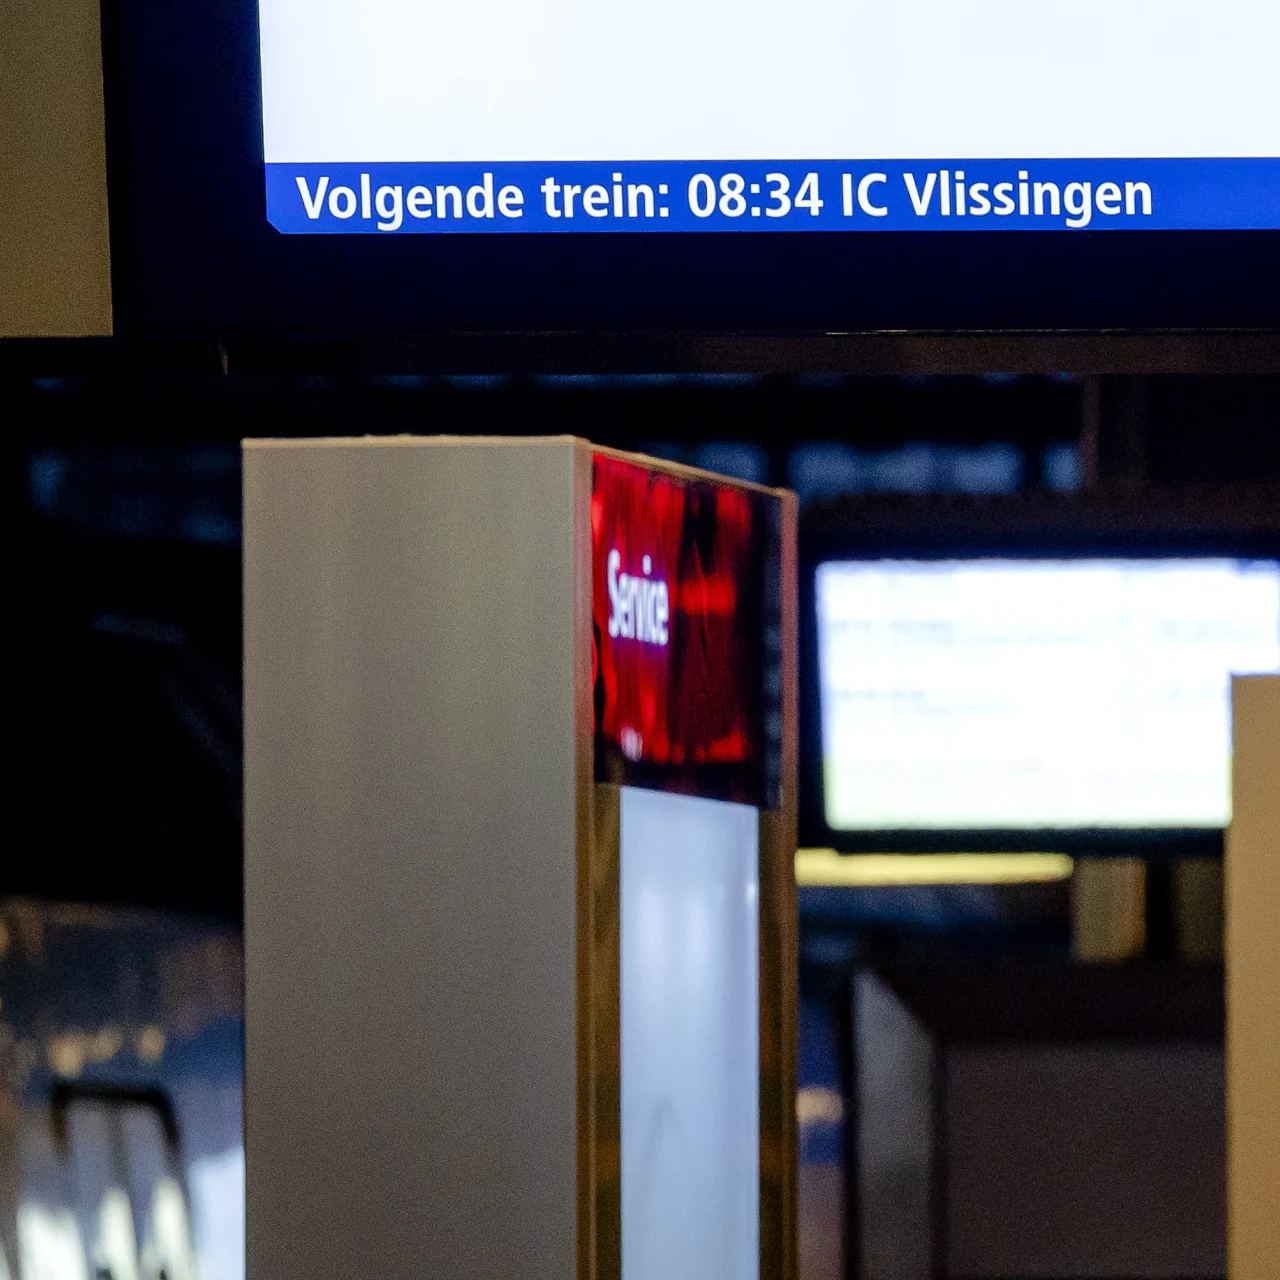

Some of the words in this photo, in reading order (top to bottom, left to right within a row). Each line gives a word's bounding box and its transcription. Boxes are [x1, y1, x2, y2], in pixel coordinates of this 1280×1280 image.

[295, 172, 524, 231] Volgende
[540, 172, 669, 218] trein:
[687, 172, 824, 218] 08:34
[841, 172, 888, 217] IC
[902, 169, 1153, 228] Vlissingen
[607, 547, 669, 646] Service
